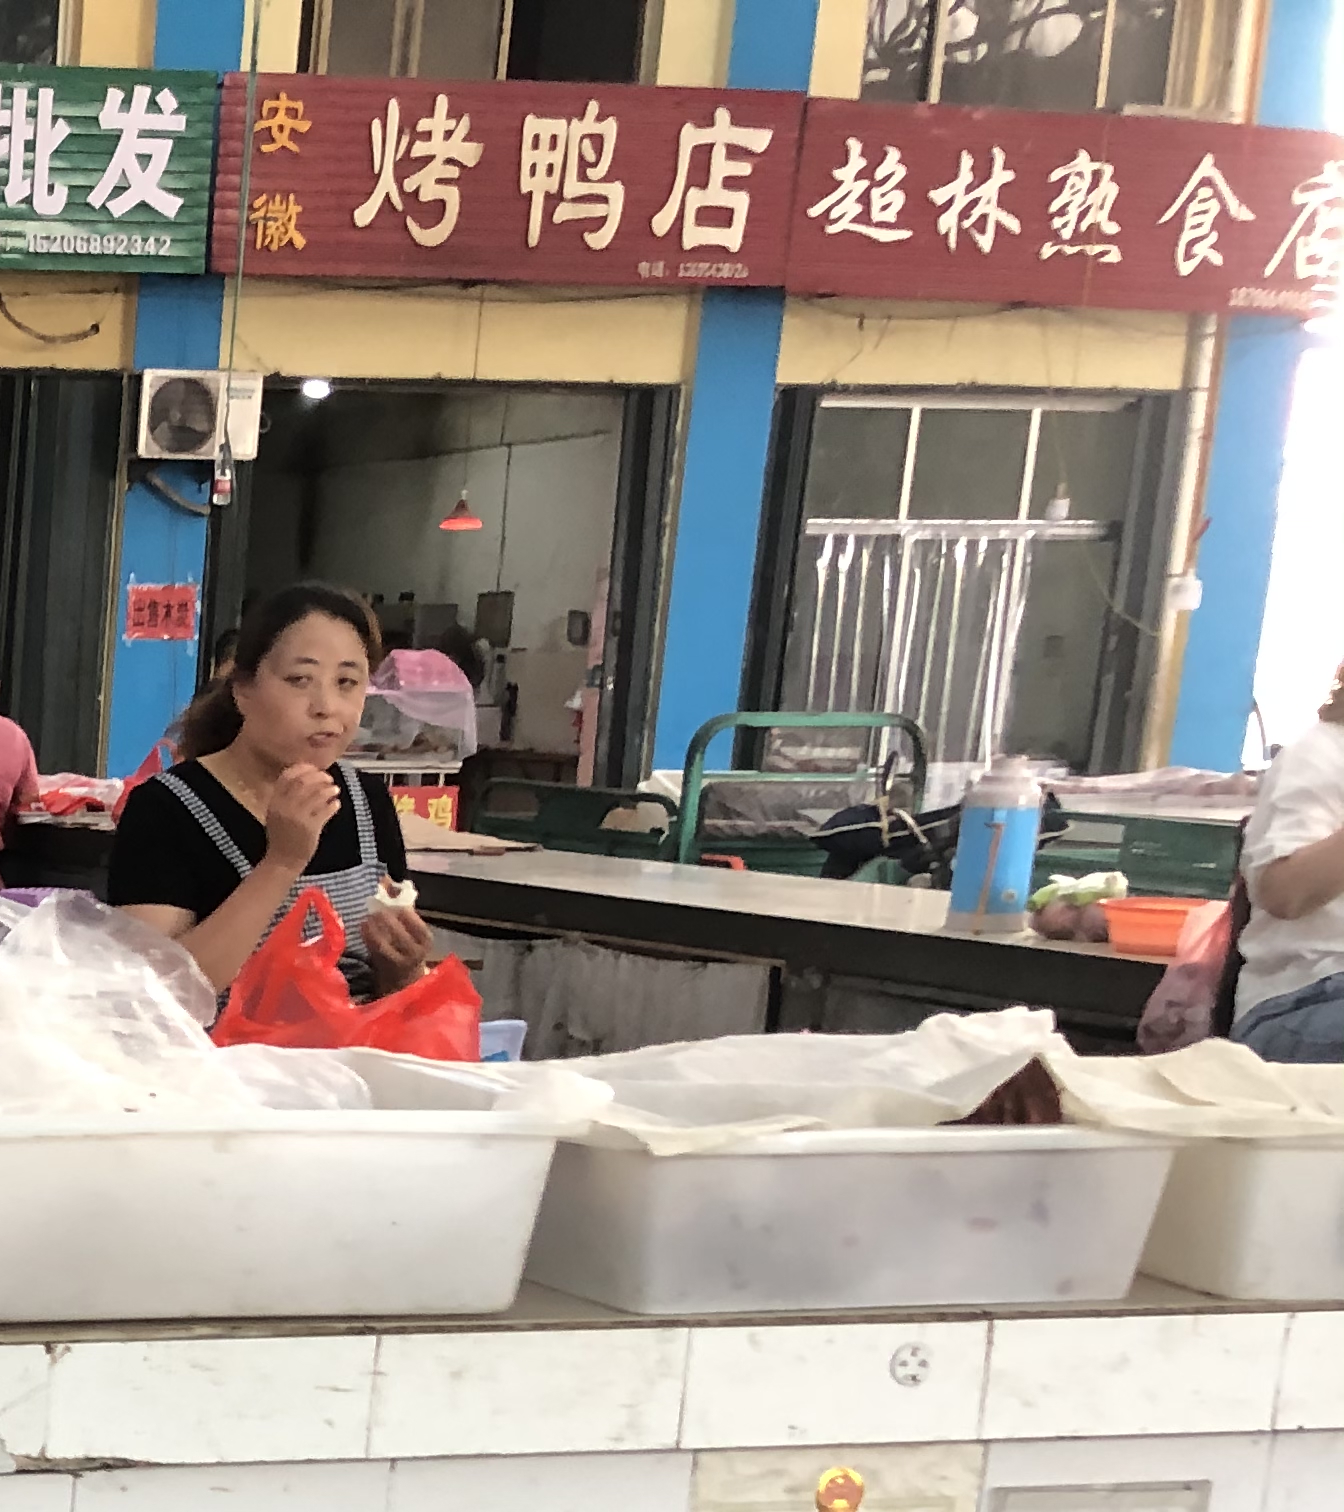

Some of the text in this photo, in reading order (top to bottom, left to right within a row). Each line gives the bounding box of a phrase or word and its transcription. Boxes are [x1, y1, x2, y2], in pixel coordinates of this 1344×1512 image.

[249, 91, 312, 252] 安徽
[353, 93, 773, 252] 烤鸭店
[807, 137, 1344, 280] 超林熟食店
